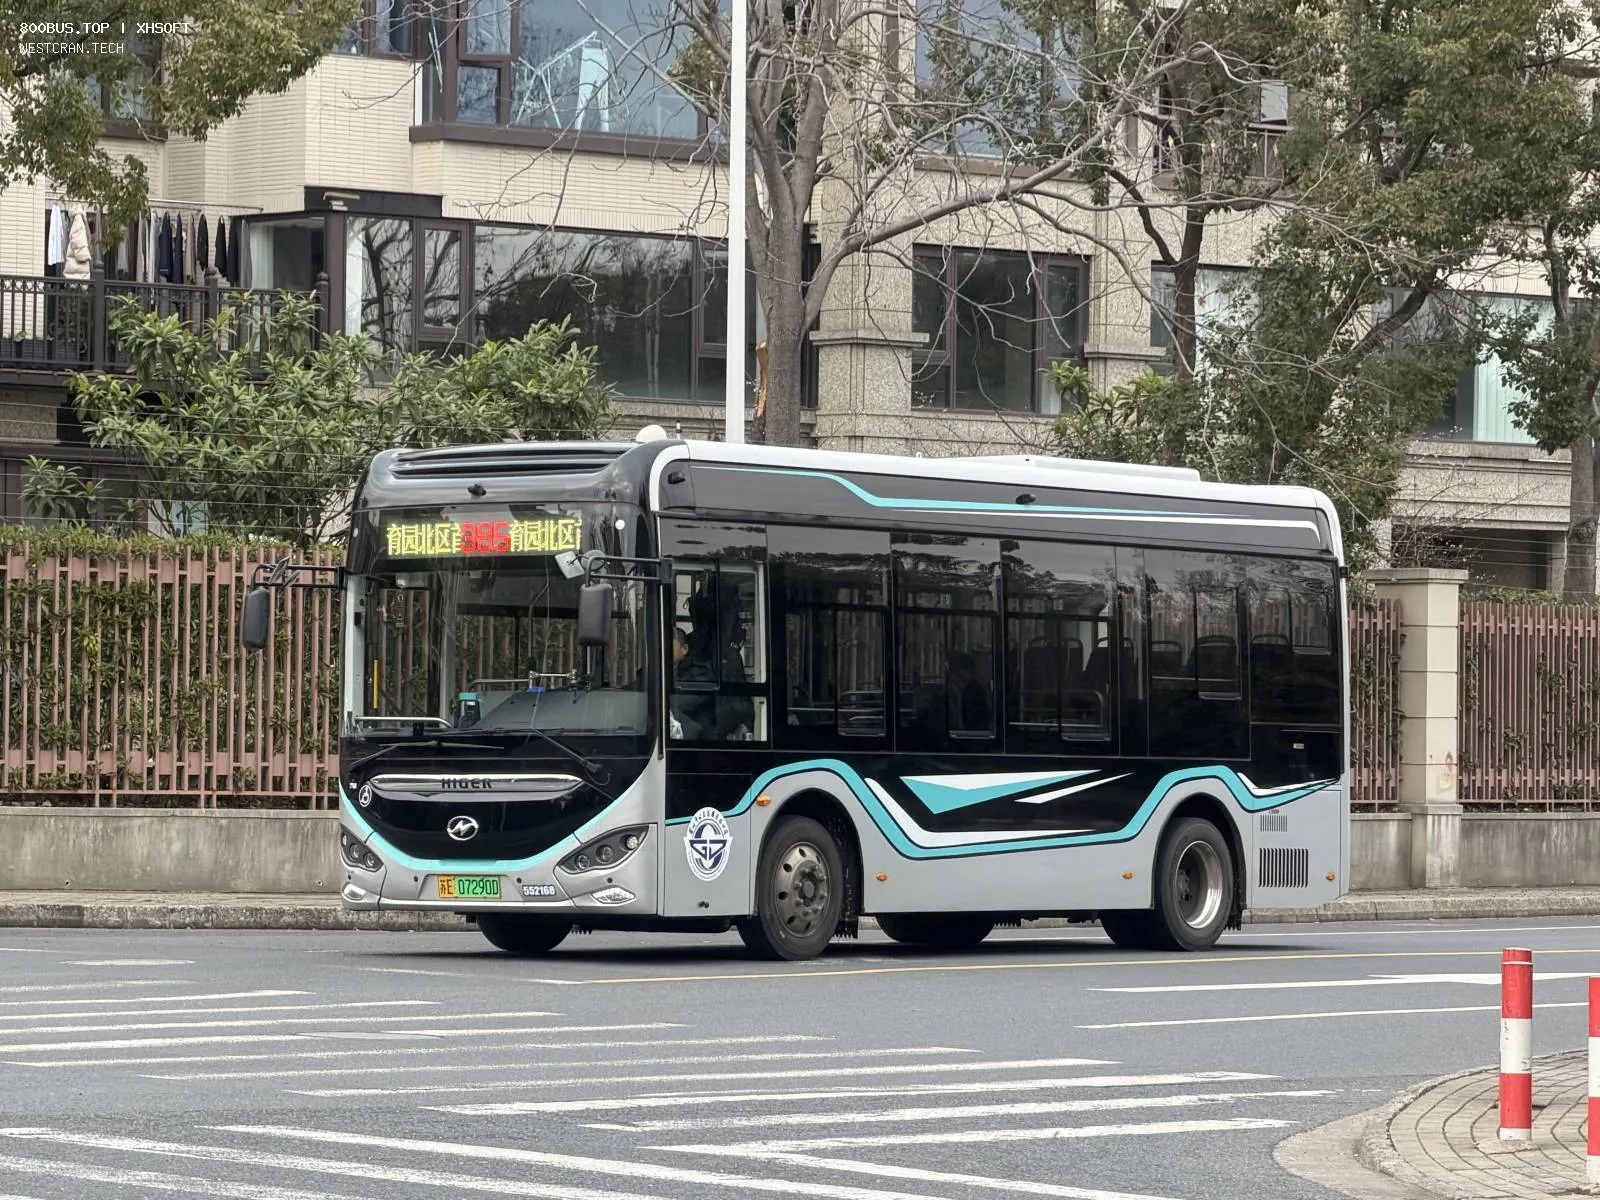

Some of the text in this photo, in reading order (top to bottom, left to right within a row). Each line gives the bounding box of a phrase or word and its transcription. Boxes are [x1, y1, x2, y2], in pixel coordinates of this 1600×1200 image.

[461, 521, 511, 554] 385
[441, 777, 493, 790] HIGER
[522, 885, 556, 896] 552168
